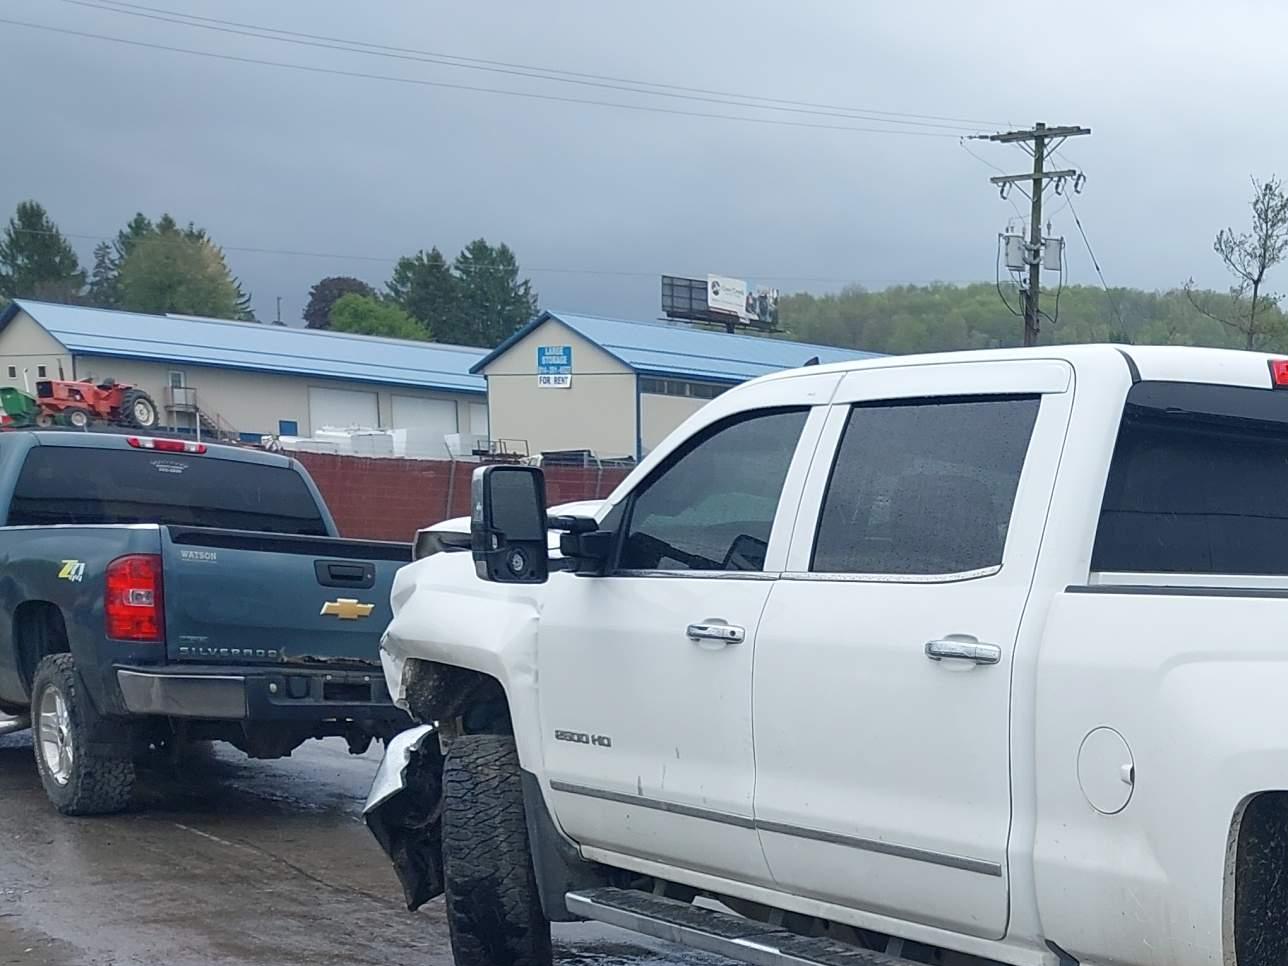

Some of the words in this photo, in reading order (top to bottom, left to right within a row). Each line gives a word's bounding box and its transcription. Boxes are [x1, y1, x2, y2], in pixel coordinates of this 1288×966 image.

[539, 376, 551, 385] FOR
[553, 376, 569, 385] RENT
[180, 550, 217, 561] WATSON
[179, 646, 278, 658] SILVERADO
[591, 734, 612, 748] HD
